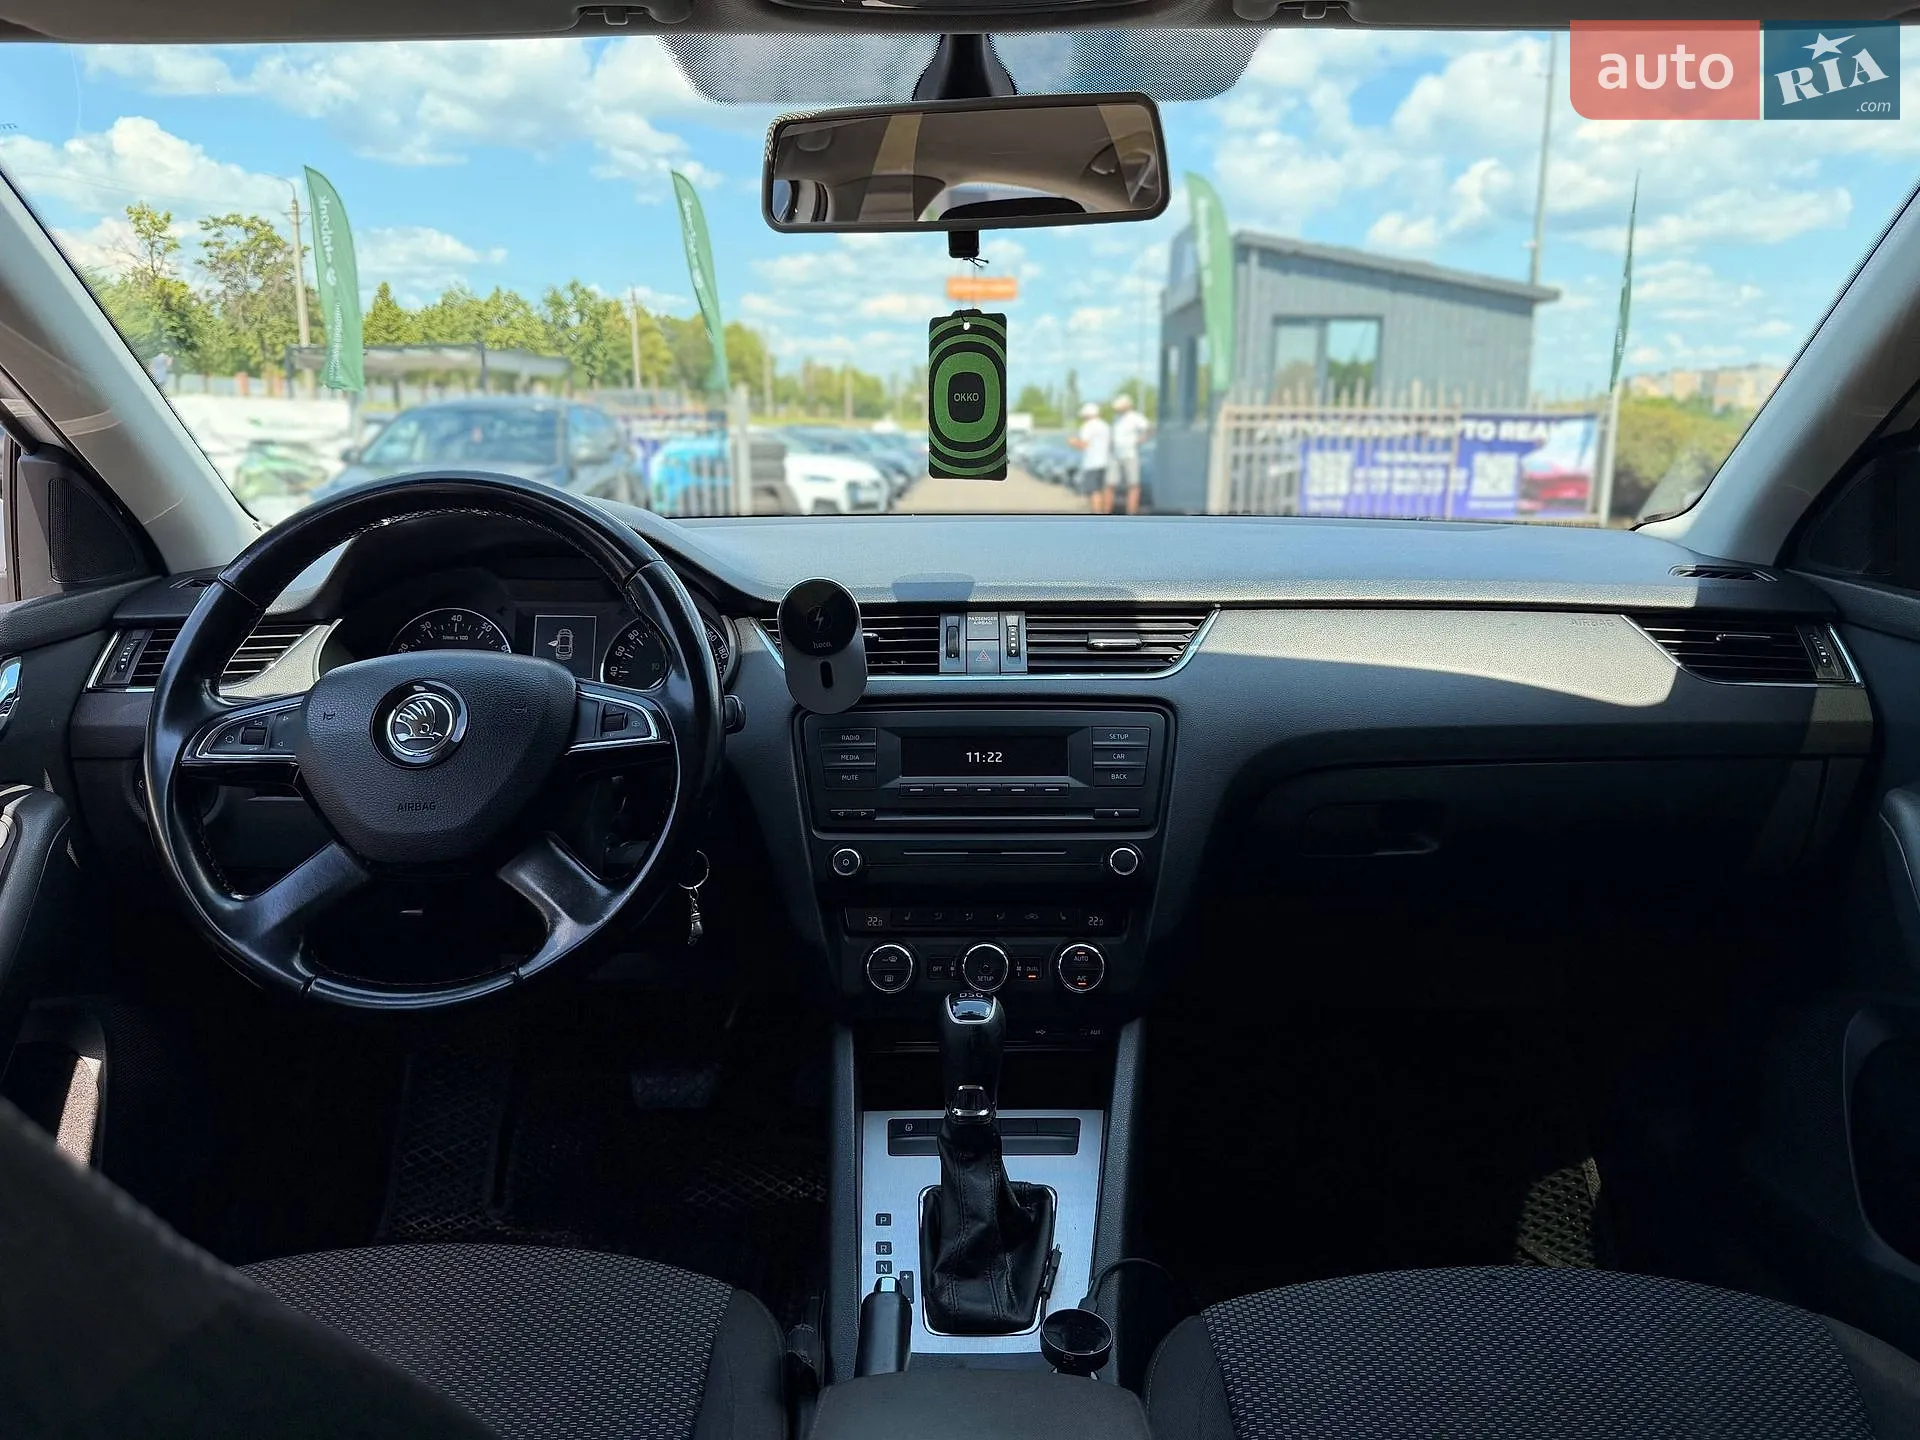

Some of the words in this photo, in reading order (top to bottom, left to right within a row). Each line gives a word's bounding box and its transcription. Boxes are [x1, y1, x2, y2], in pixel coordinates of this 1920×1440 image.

[953, 392, 979, 402] OKKO
[451, 614, 462, 622] 40
[1570, 618, 1614, 627] AIRBAG
[420, 621, 432, 632] 30
[480, 621, 493, 632] 50
[628, 629, 640, 641] 80
[615, 645, 626, 657] 60
[718, 645, 729, 659] 180
[610, 666, 618, 677] 40
[966, 751, 1003, 763] 11:22
[396, 801, 435, 812] AIRBAG
[880, 1216, 887, 1224] P
[880, 1245, 888, 1253] R
[880, 1264, 888, 1272] N
